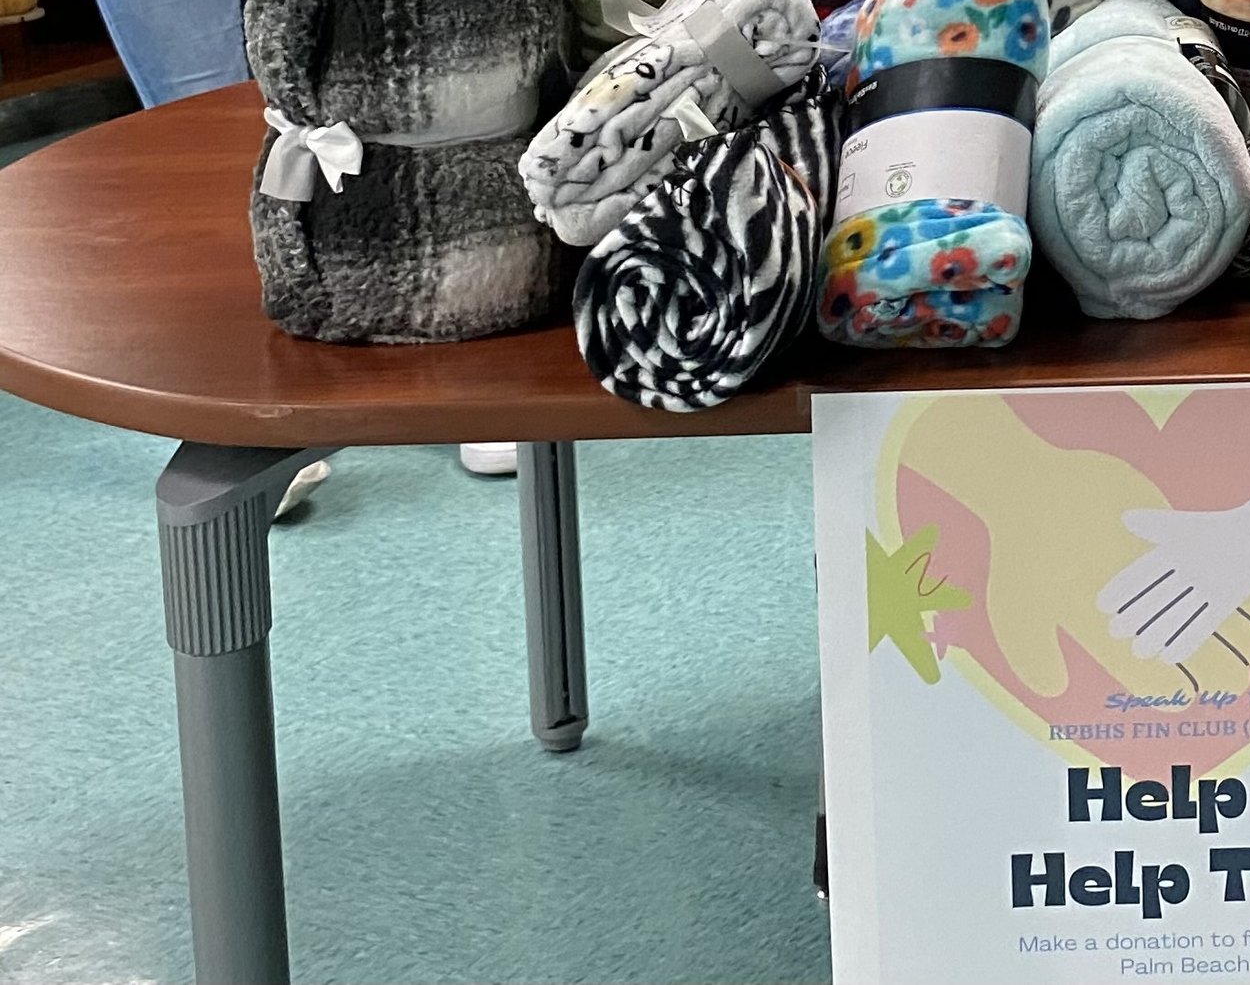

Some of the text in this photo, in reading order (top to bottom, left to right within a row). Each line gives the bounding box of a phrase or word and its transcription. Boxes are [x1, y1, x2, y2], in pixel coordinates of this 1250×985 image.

[1104, 689, 1192, 709] Speak
[1200, 690, 1238, 709] Up
[1048, 722, 1126, 742] RPBHS
[1132, 722, 1170, 739] FIN
[1178, 719, 1237, 738] CLUB
[1067, 764, 1248, 835] Help
[1010, 850, 1191, 920] Help
[1018, 935, 1078, 953] Make
[1084, 938, 1098, 952] a
[1105, 932, 1204, 951] donation
[1210, 933, 1236, 949] to
[1120, 957, 1174, 976] Palm
[1180, 955, 1250, 975] Beach
